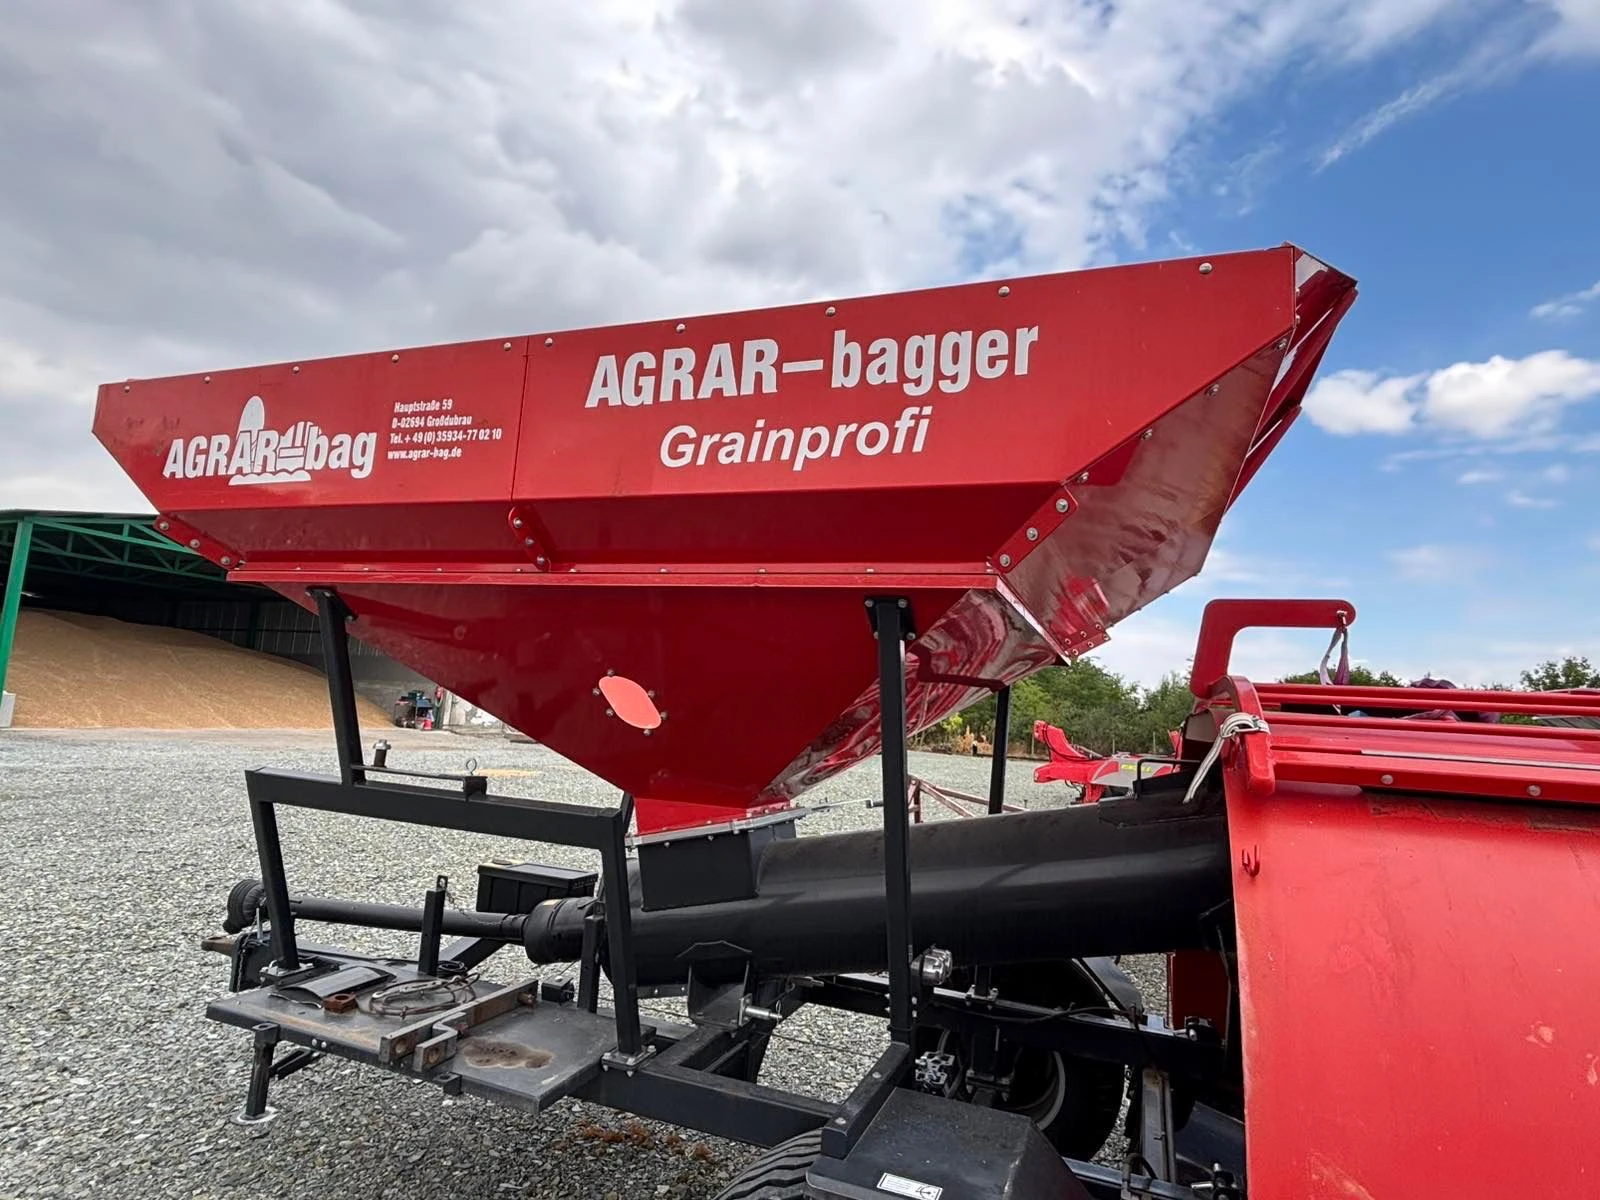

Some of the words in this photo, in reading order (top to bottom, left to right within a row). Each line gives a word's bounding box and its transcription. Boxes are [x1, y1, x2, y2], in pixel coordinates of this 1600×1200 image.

[394, 400, 440, 414] Hauptstraße
[441, 398, 453, 410] 59
[391, 416, 425, 429] D-02694
[390, 432, 403, 444] Tel.
[659, 405, 933, 472] Grainprofi
[387, 446, 462, 461] www.agrar-bag.de
